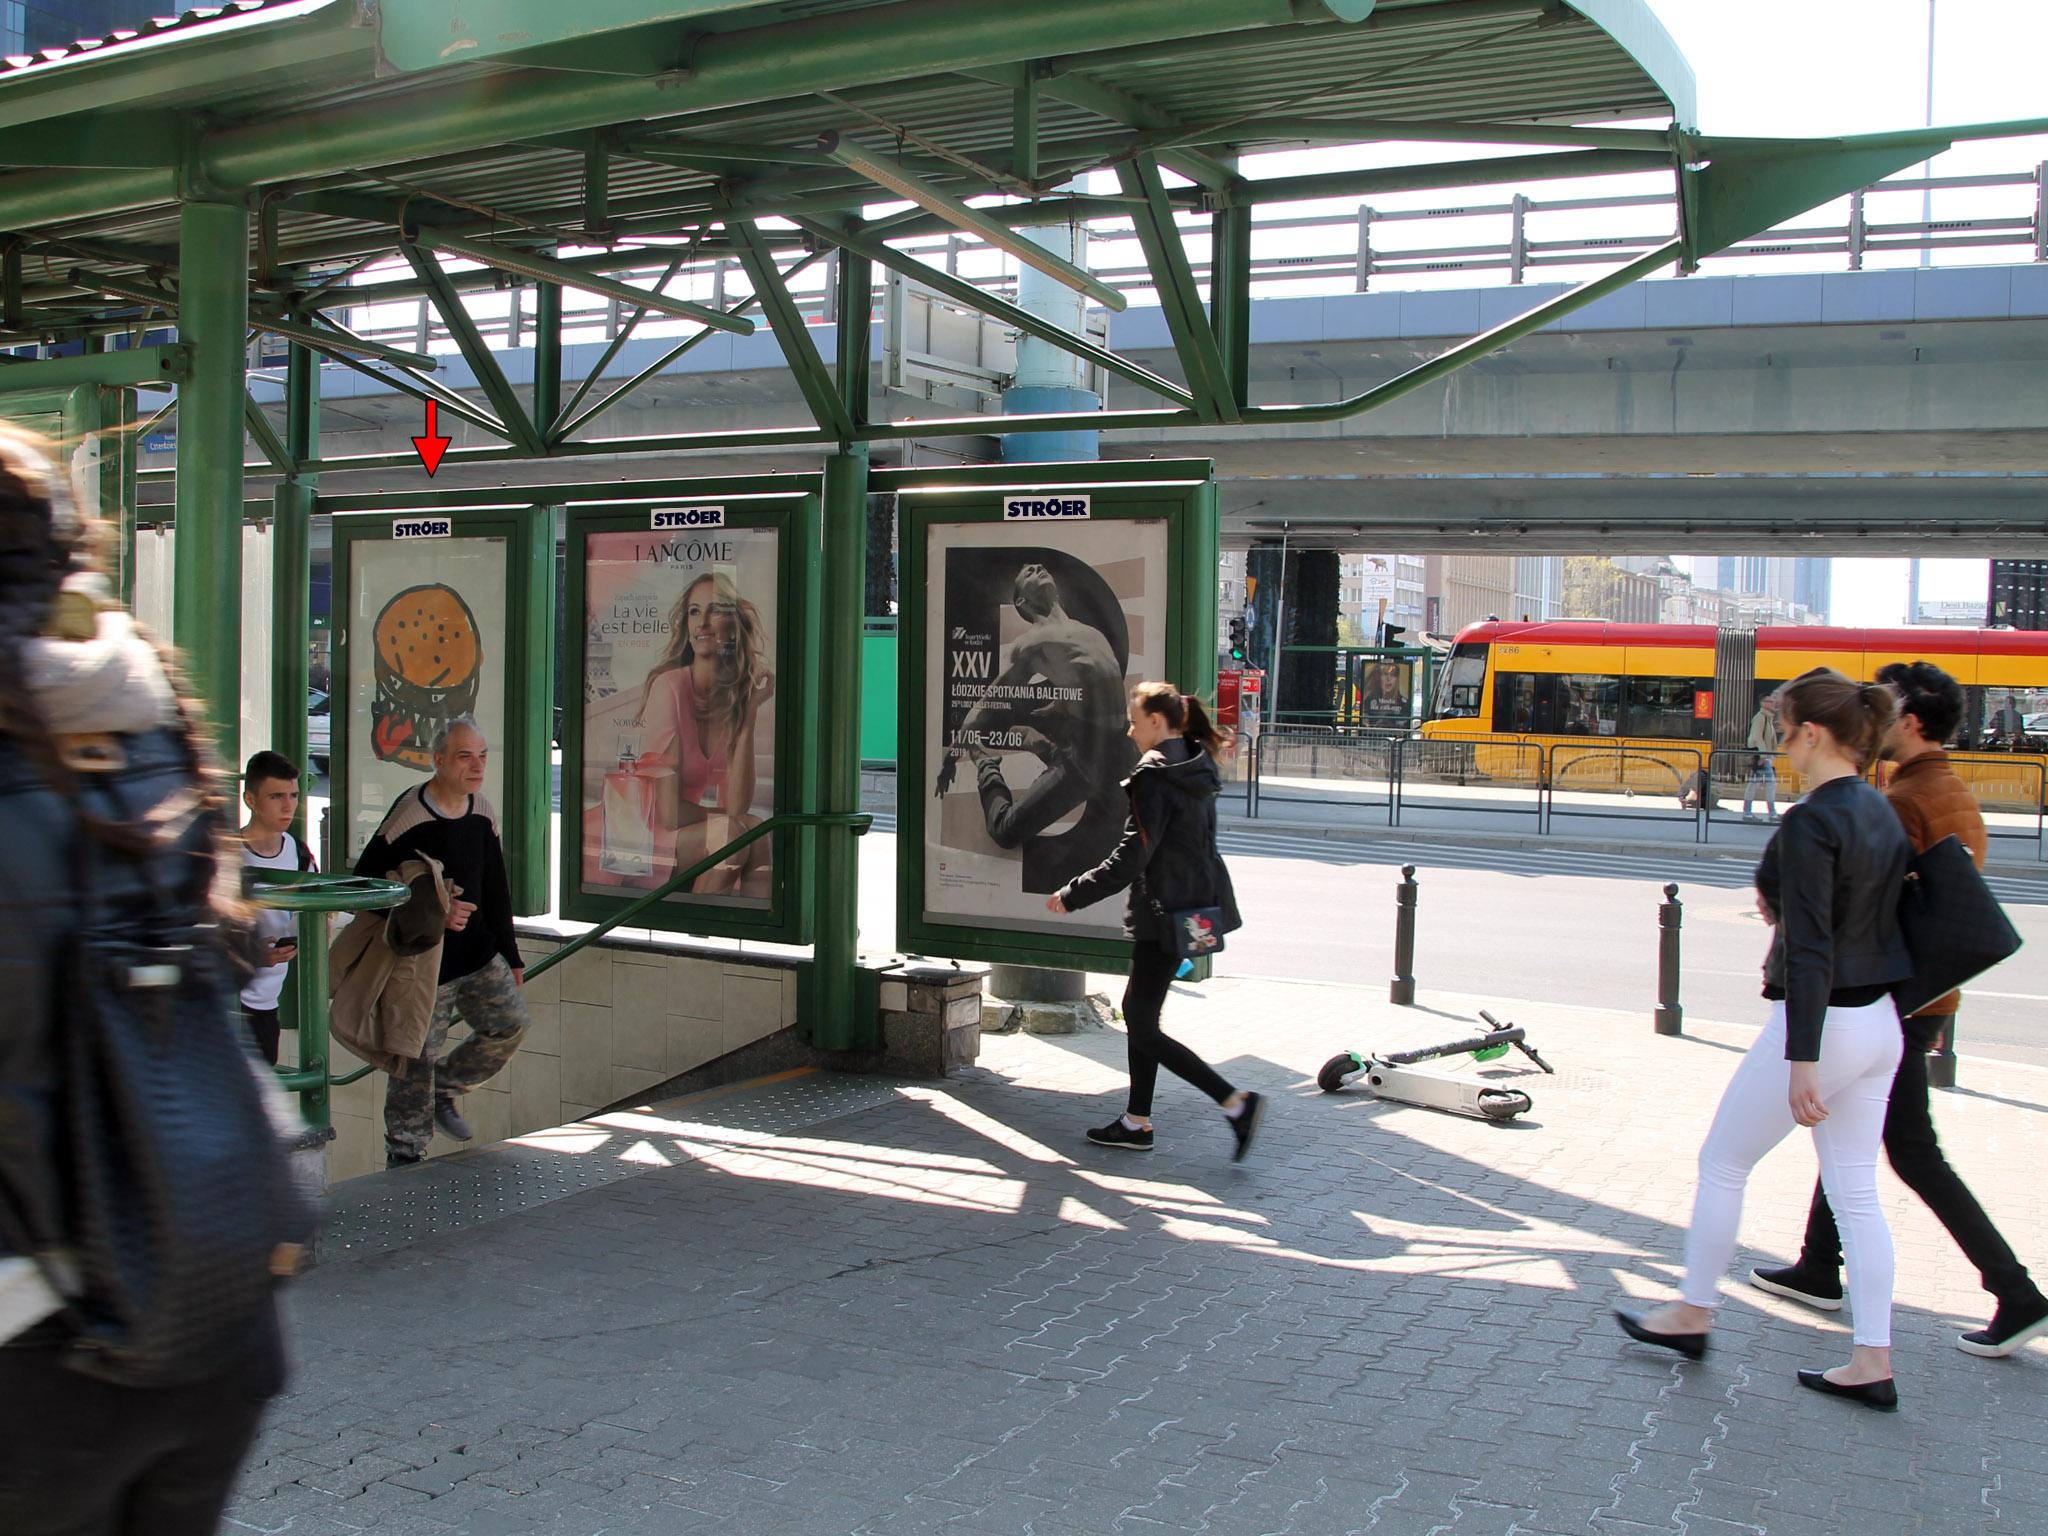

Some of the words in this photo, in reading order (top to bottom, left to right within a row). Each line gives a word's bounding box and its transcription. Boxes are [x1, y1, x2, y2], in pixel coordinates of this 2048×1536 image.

[1008, 499, 1087, 517] STRÖER
[654, 509, 722, 526] STRÖER
[395, 521, 449, 536] STRÖER
[635, 539, 733, 562] LANCÔME
[613, 604, 630, 619] La
[634, 604, 658, 619] vie
[601, 622, 628, 635] est
[632, 620, 670, 635] belle
[952, 651, 992, 679] XXV
[952, 682, 986, 698] ŁÓDZKIE
[987, 685, 1035, 699] SPOTKANIA
[1036, 687, 1083, 701] BALETOWE
